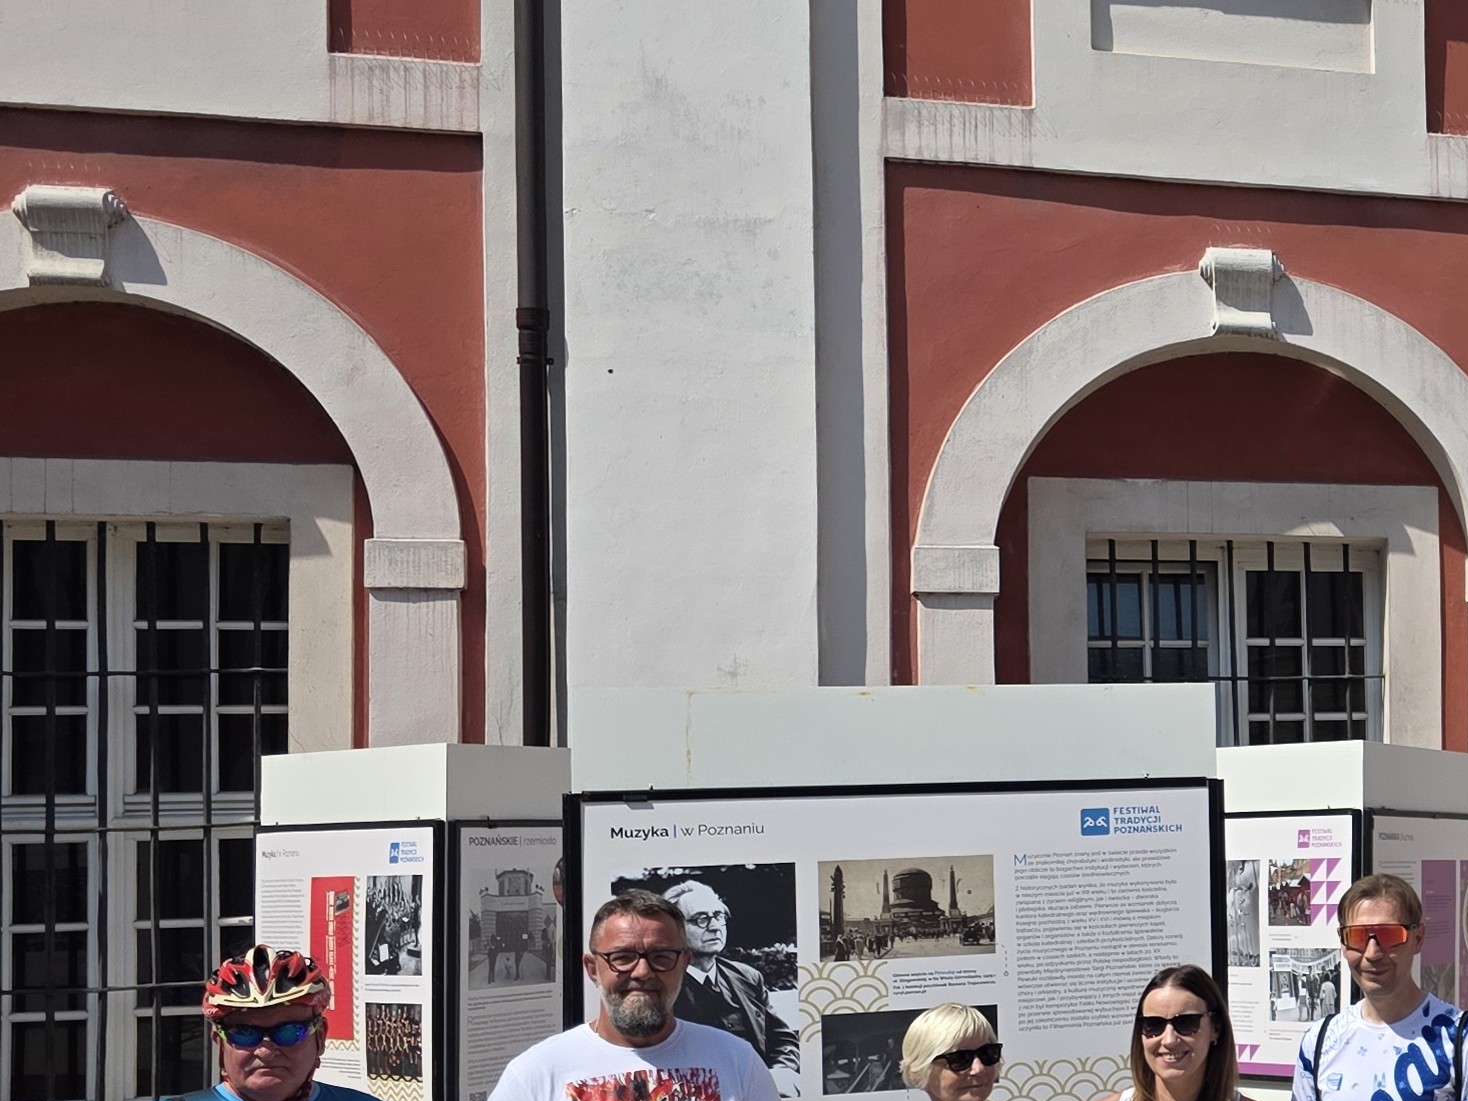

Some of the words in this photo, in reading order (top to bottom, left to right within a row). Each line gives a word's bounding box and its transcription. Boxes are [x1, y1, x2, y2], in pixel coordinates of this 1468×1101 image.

[1113, 806, 1160, 815] FESTIWAL
[1114, 816, 1161, 825] TRADYCJI
[611, 826, 669, 840] Muzyka
[681, 827, 694, 836] w
[698, 822, 764, 836] Poznaniu
[1114, 824, 1182, 834] POZNAŃSKICH
[469, 835, 518, 846] POZNAŃSKIE
